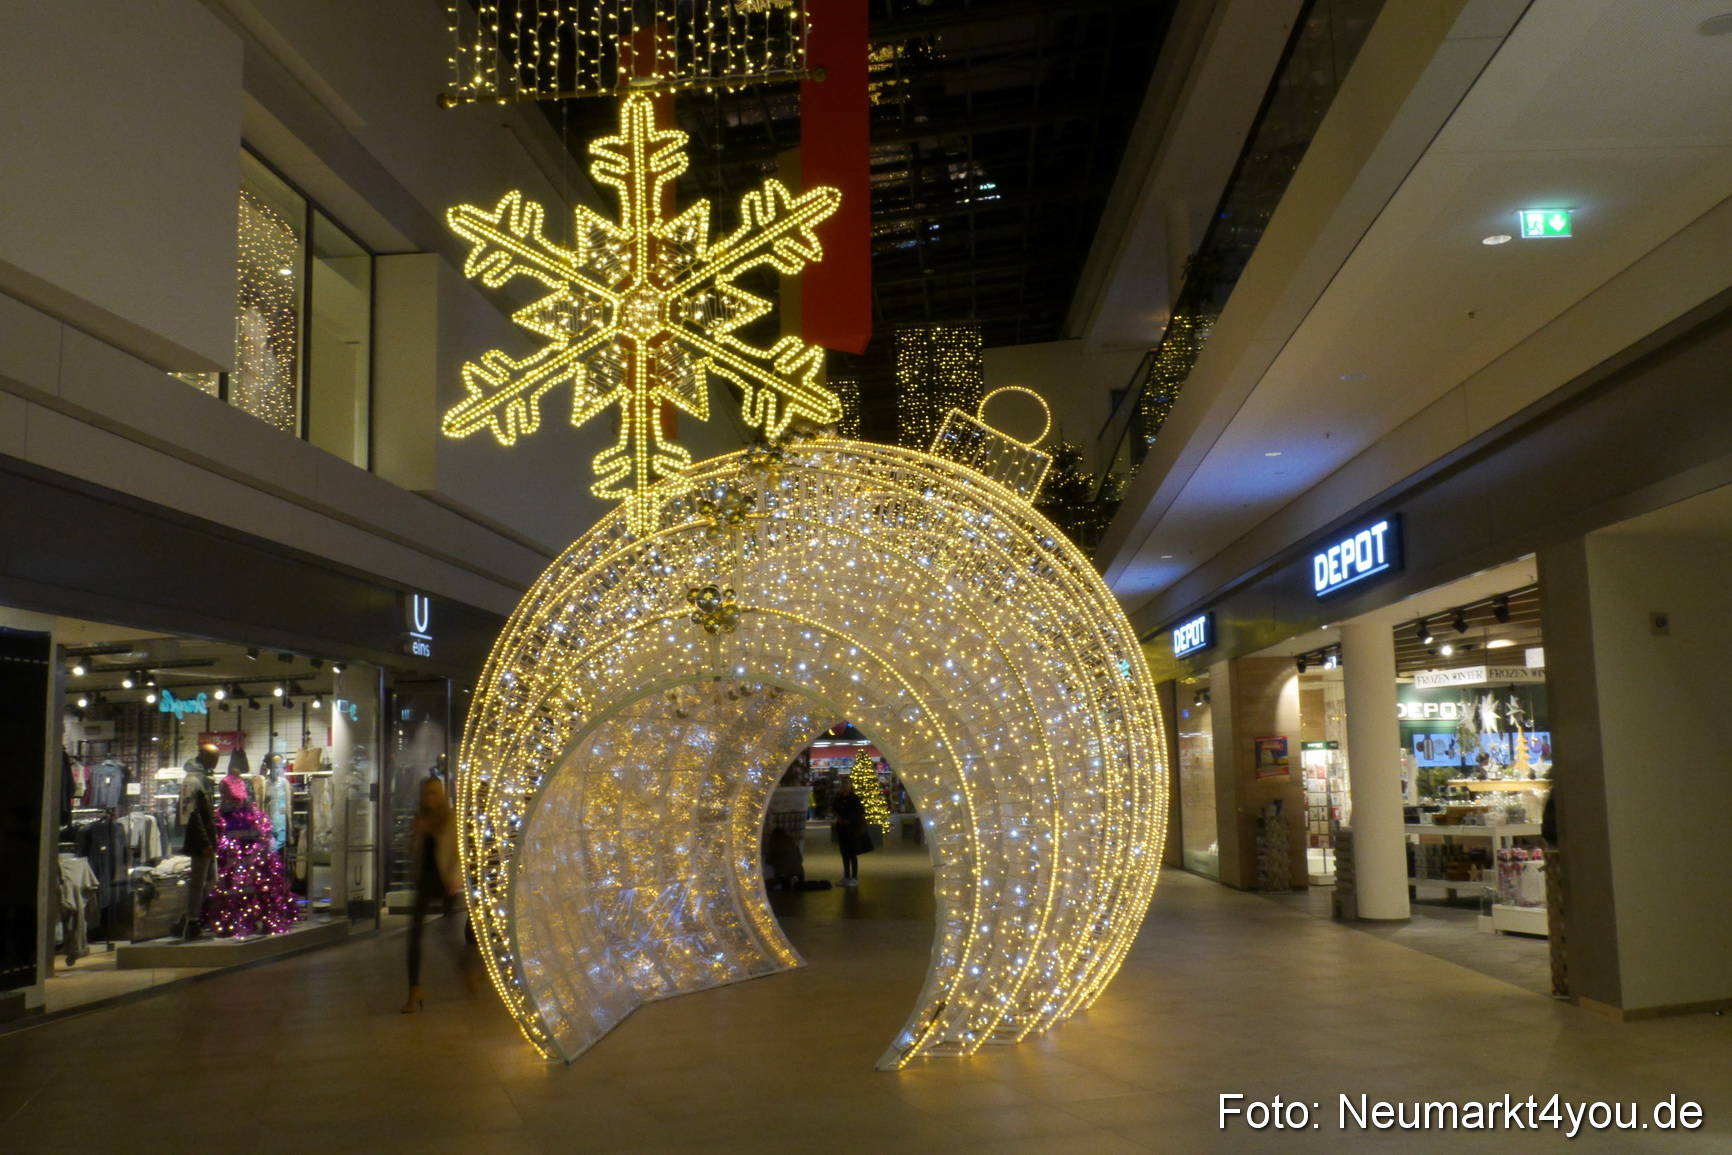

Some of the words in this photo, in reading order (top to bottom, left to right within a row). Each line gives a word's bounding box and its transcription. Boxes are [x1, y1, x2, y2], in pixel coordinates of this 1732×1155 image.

[1314, 521, 1387, 591] DEPOT
[414, 594, 429, 633] U
[412, 640, 431, 657] eins
[1173, 616, 1205, 654] DEPOT
[1416, 673, 1450, 685] FROZEN
[1452, 669, 1483, 681] WINTER
[1489, 668, 1528, 679] FROZEN
